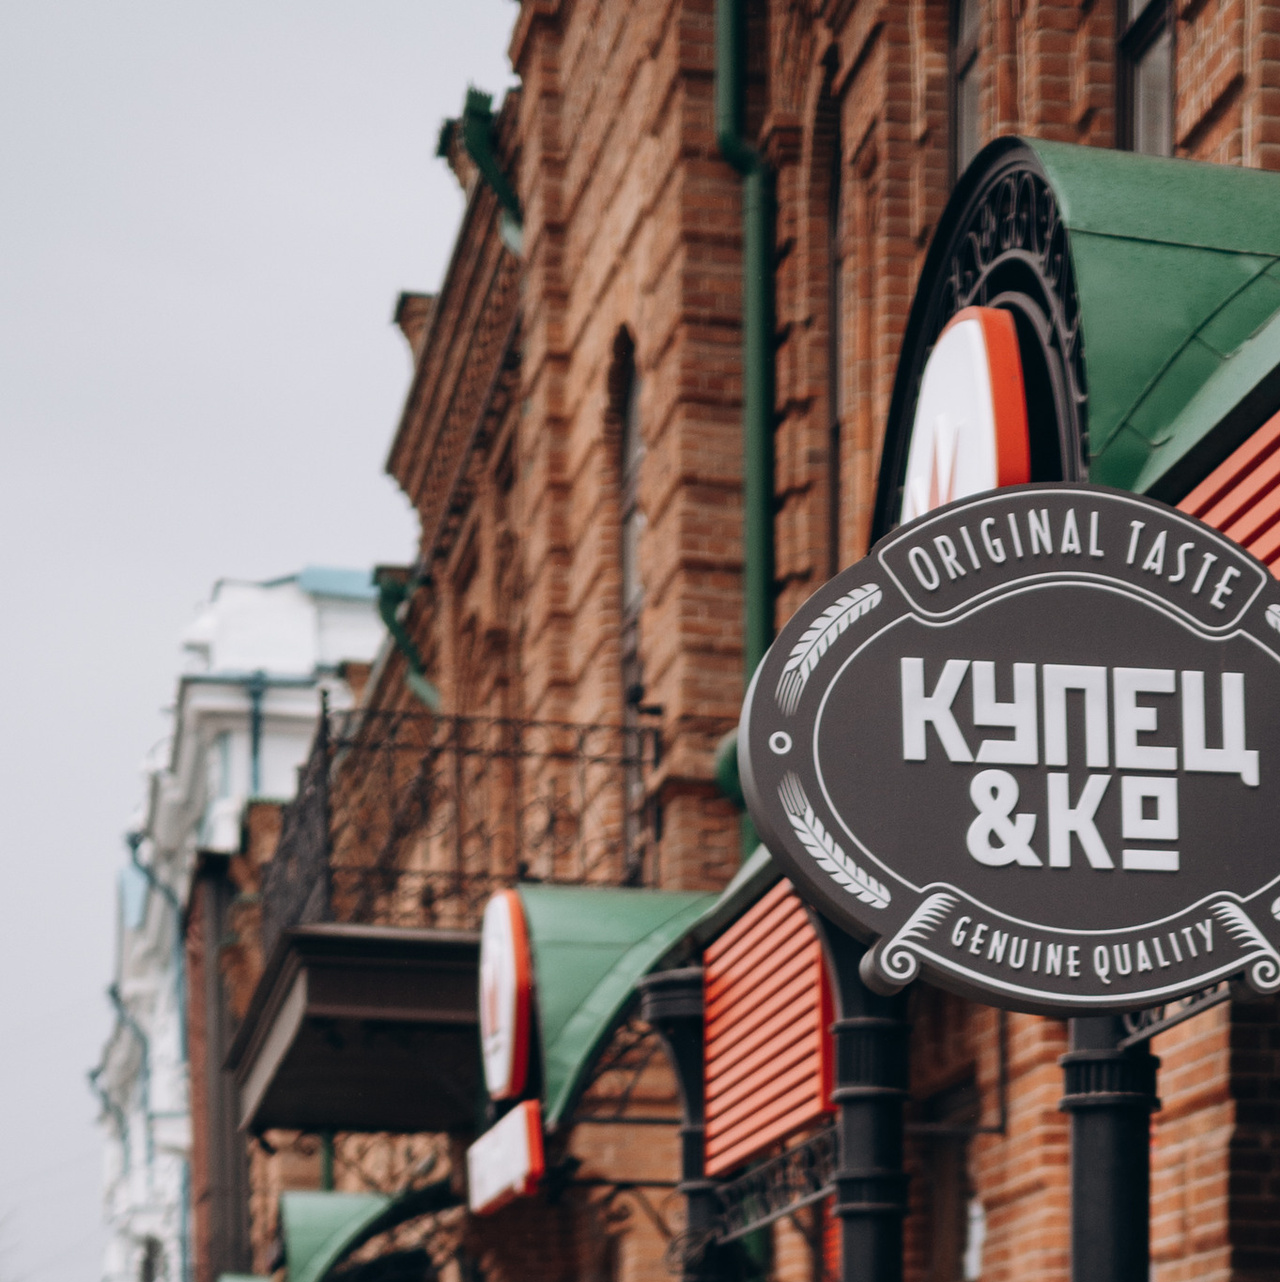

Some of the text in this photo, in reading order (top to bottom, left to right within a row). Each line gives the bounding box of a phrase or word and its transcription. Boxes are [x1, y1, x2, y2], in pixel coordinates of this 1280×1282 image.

[908, 508, 1241, 609] ORIGINAL TASTE
[900, 656, 1260, 787] КУПЕЦ
[951, 916, 1213, 984] GENUINE QUALITY
